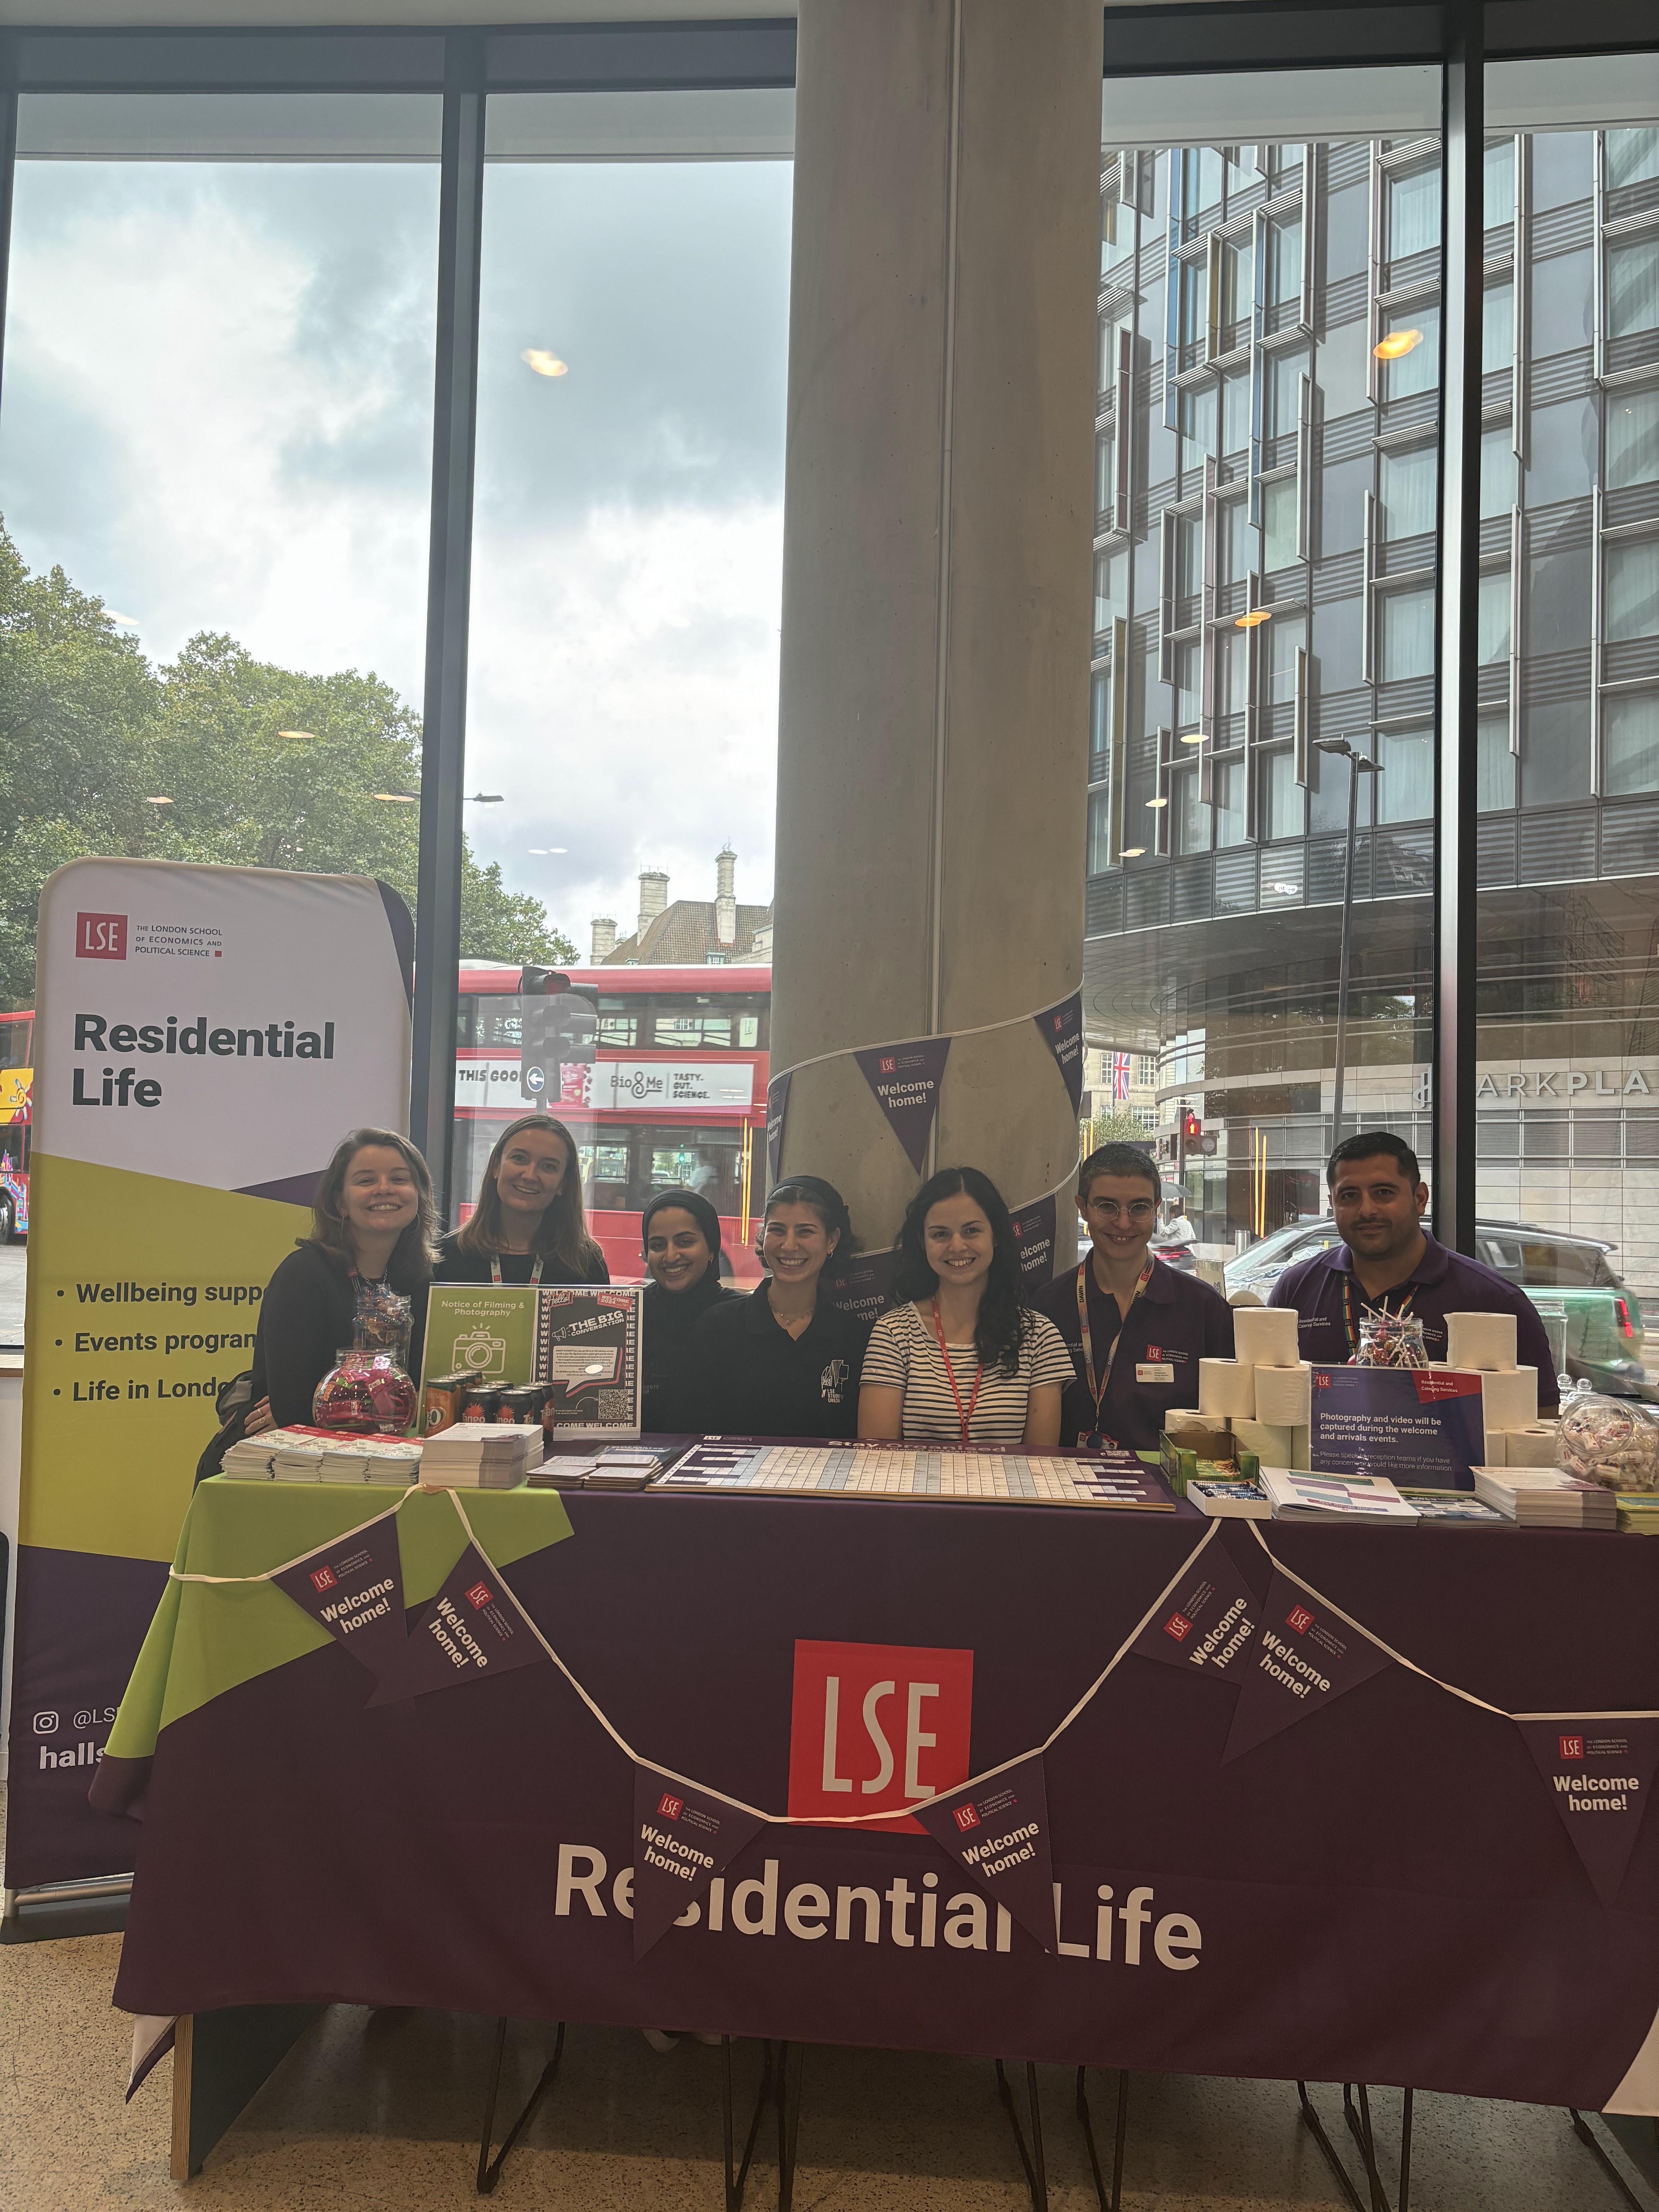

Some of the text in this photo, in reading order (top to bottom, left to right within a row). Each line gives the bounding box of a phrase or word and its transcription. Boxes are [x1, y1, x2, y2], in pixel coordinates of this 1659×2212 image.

[85, 921, 118, 951] LSE
[151, 925, 187, 934] LONDON
[149, 936, 203, 945] ECONOMICS
[135, 946, 175, 955] POLITICAL
[74, 1013, 335, 1060] Residential
[1055, 1033, 1080, 1054] Welcome
[1061, 1045, 1079, 1064] home!
[882, 1060, 893, 1071] LSE
[459, 1070, 522, 1082] THIS GOO
[1476, 1070, 1649, 1097] ARKPLA
[72, 1067, 162, 1108] Life
[877, 1080, 934, 1096] Welcome
[888, 1092, 927, 1108] home!
[1020, 1239, 1050, 1259] elcome
[76, 1282, 197, 1306] Wellbeing
[548, 1292, 570, 1305] Hello!
[601, 1295, 629, 1304] WELCOME
[454, 1309, 511, 1317] Photography
[484, 1301, 516, 1310] Filming
[857, 1307, 879, 1321] me!
[568, 1310, 624, 1332] THE BIG
[571, 1318, 625, 1336] CONVERSATION
[75, 1332, 157, 1352] Events
[1149, 1348, 1159, 1359] LSE
[73, 1380, 120, 1401] Life
[128, 1379, 149, 1399] in
[1319, 1376, 1329, 1386] LSE
[1320, 1413, 1371, 1423] Photography
[1320, 1423, 1355, 1432] captured
[1357, 1424, 1383, 1434] during
[1401, 1426, 1438, 1435] welcome
[1336, 1433, 1367, 1441] arrivals
[886, 1443, 1006, 1452] Organised
[315, 1570, 333, 1588] LSE
[320, 1578, 394, 1622] Welcome
[470, 1586, 488, 1605] LSE
[340, 1597, 391, 1634] home!
[1290, 1609, 1310, 1629] LSE
[436, 1597, 488, 1668] Welcome
[1169, 1617, 1188, 1637] LSE
[1189, 1598, 1247, 1665] Welcome
[428, 1618, 469, 1668] home!
[1211, 1617, 1255, 1668] home!
[1262, 1630, 1330, 1692] Welcome
[1259, 1653, 1311, 1698] home!
[73, 1707, 120, 1729] @LS
[821, 1675, 940, 1800] LSE
[1563, 1740, 1580, 1755] LSE
[1553, 1774, 1639, 1791] Welcome
[983, 1795, 998, 1805] LONDON
[998, 1789, 1013, 1798] SCHOOL
[984, 1798, 1007, 1810] ECONOMICS
[1568, 1795, 1627, 1811] home!
[662, 1798, 679, 1816] LSE
[981, 1801, 1012, 1818] POLITICAL SCIENCE
[681, 1816, 712, 1832] POLITICAL SCIENCE
[689, 1814, 711, 1826] ECONOMICS
[691, 1809, 706, 1819] LONDON
[706, 1815, 720, 1825] SCHOOL
[957, 1808, 975, 1827] LSE
[641, 1824, 714, 1869] Welcome
[962, 1823, 1039, 1865] Welcome
[644, 1846, 697, 1882] home!
[981, 1842, 1036, 1877] home!
[1044, 1882, 1201, 1970] Life
